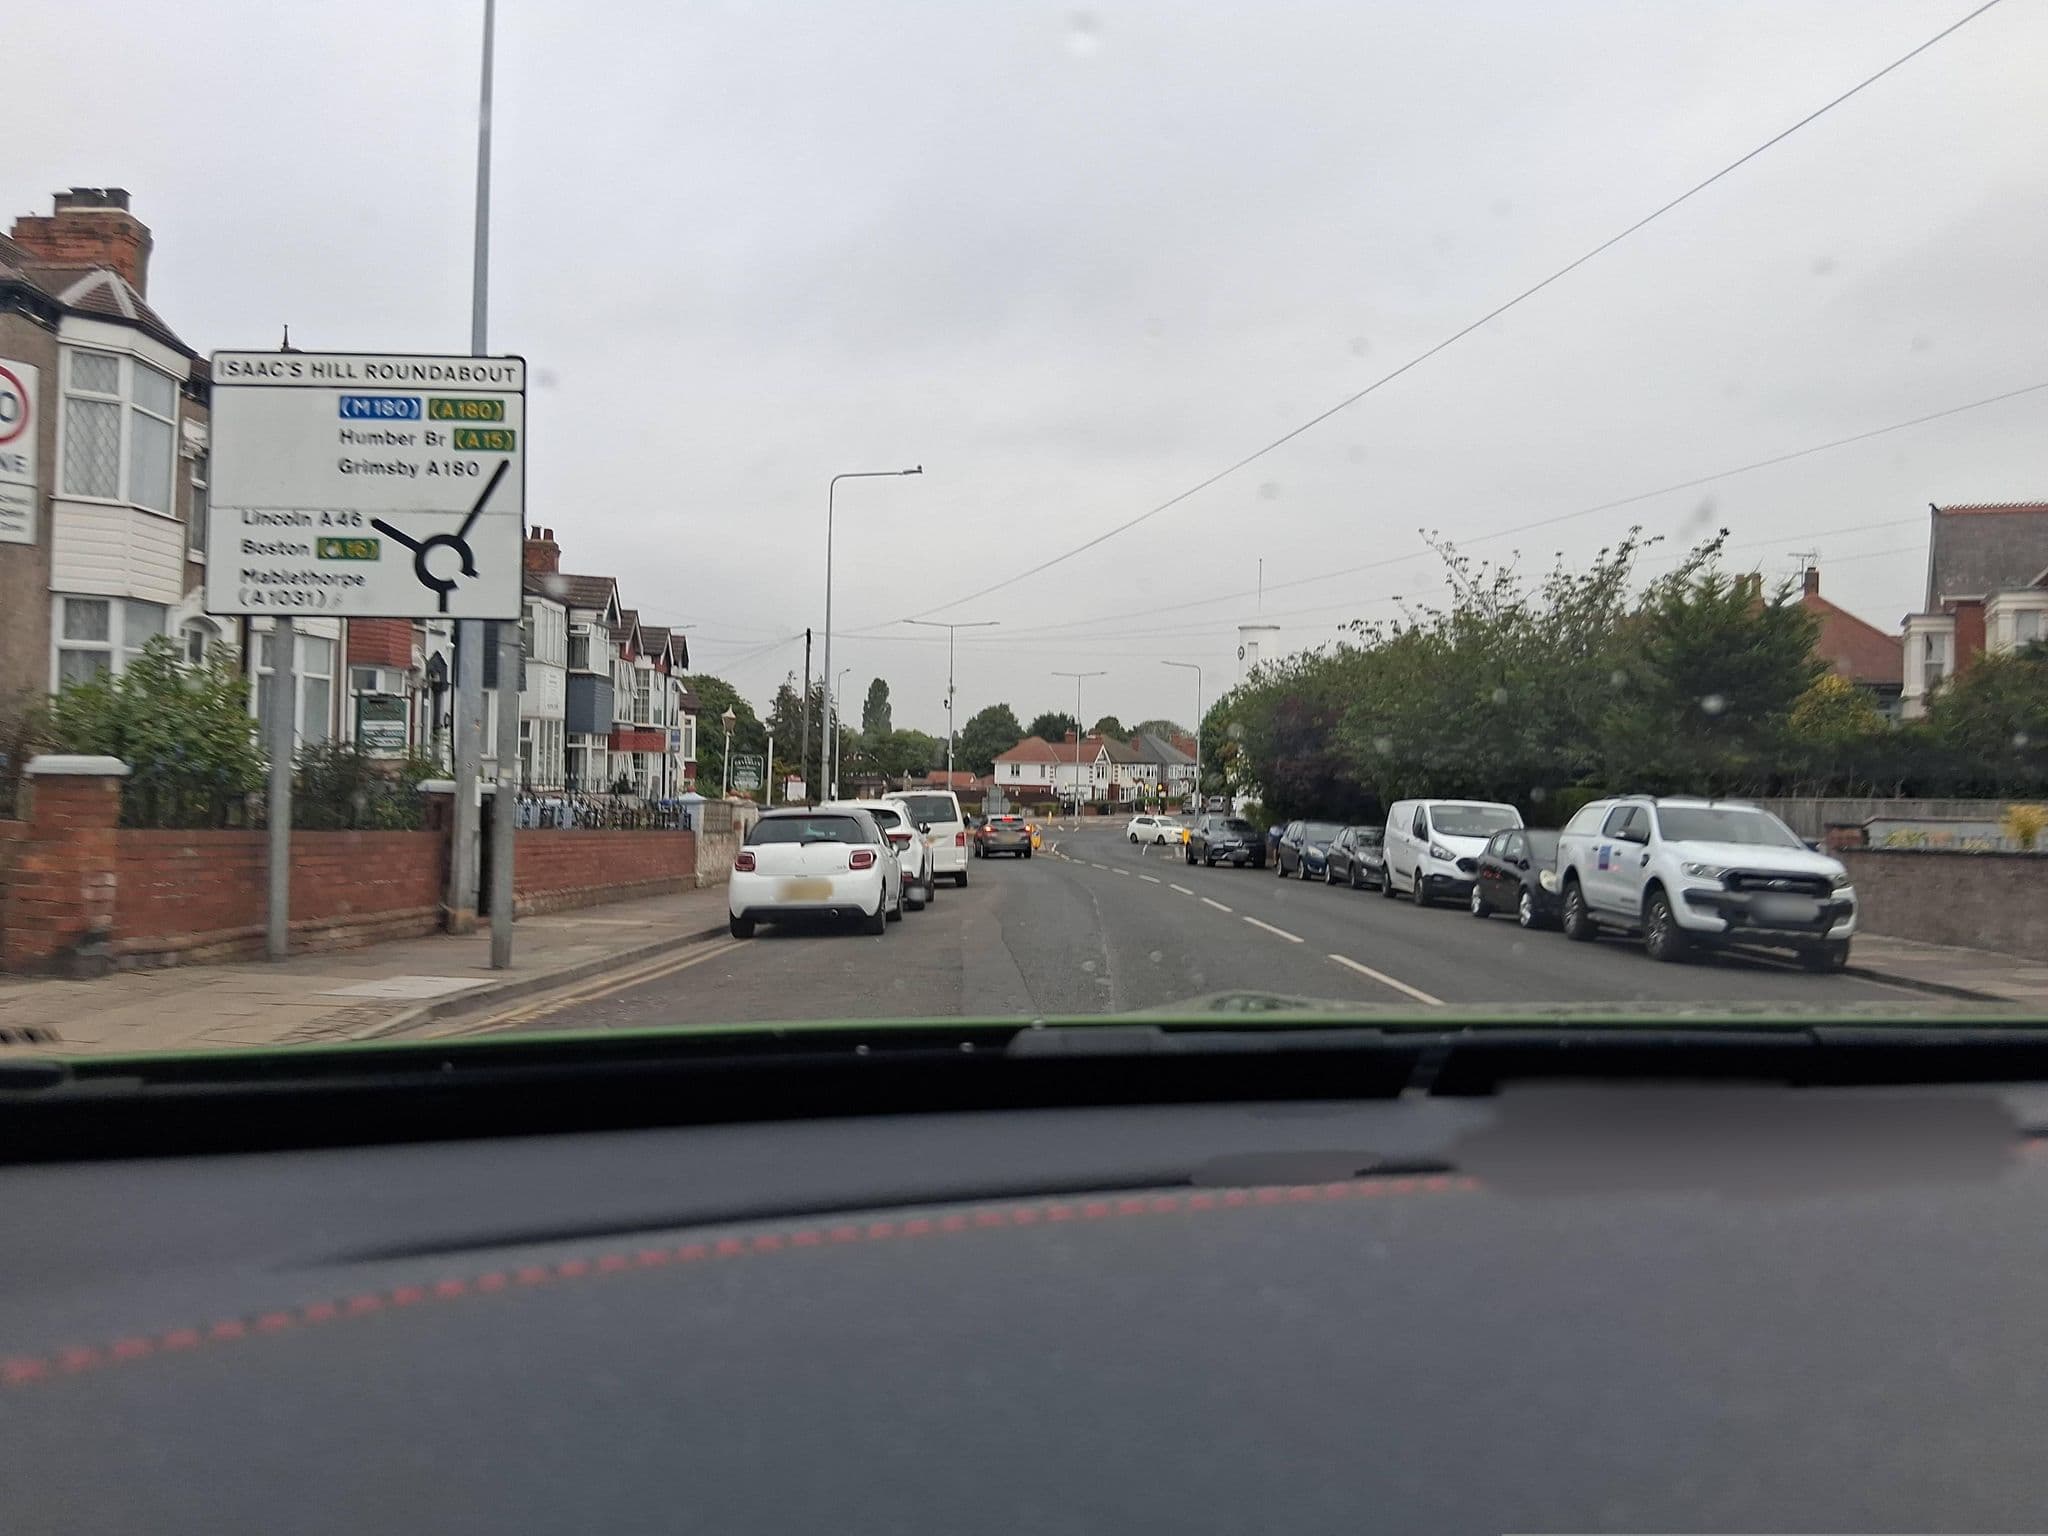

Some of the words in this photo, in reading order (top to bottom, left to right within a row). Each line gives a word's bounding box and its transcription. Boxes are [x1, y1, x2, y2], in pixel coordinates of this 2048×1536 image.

[219, 360, 303, 378] ISAAC'S
[311, 362, 358, 379] HILL
[365, 363, 516, 383] ROUNDABOUT
[340, 397, 420, 420] (M180)
[430, 399, 504, 421] (A180)
[339, 428, 417, 447] Humber
[425, 431, 447, 447] Br
[456, 429, 514, 450] (A15)
[338, 458, 420, 478] Grimsby
[426, 461, 480, 477] A180
[241, 508, 312, 527] Lincoln
[319, 510, 362, 527] A46
[240, 539, 310, 556] Boston
[240, 568, 366, 589] Mablethorpe
